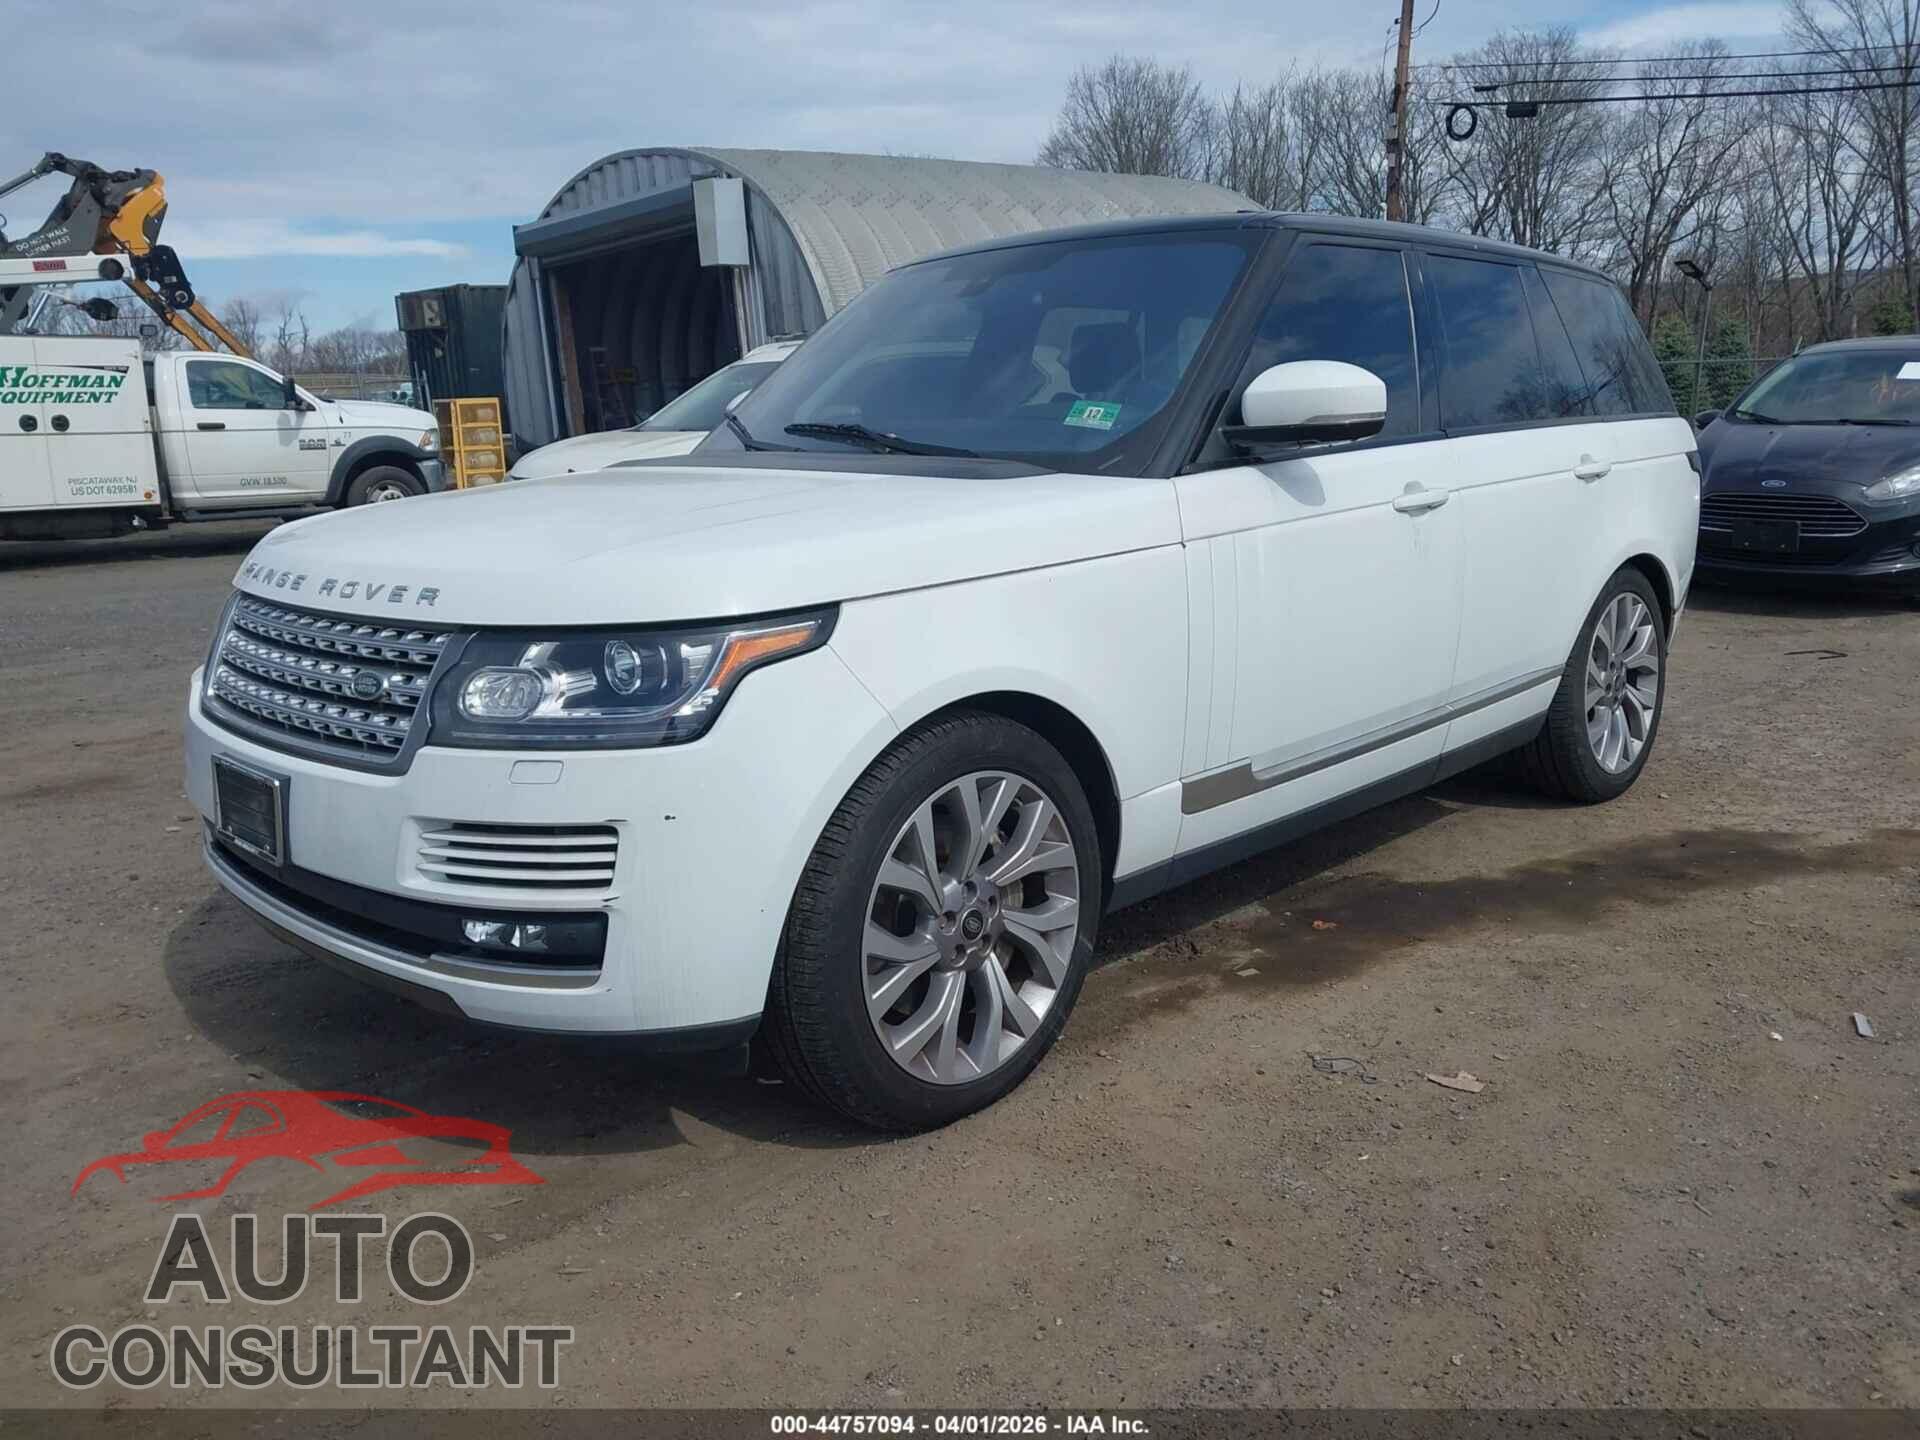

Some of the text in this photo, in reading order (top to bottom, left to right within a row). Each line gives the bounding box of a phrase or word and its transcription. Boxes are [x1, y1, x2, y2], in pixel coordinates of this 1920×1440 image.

[0, 391, 118, 404] QUIPMENT
[71, 486, 85, 496] US
[86, 486, 104, 496] DOT
[318, 578, 441, 607] ROVER
